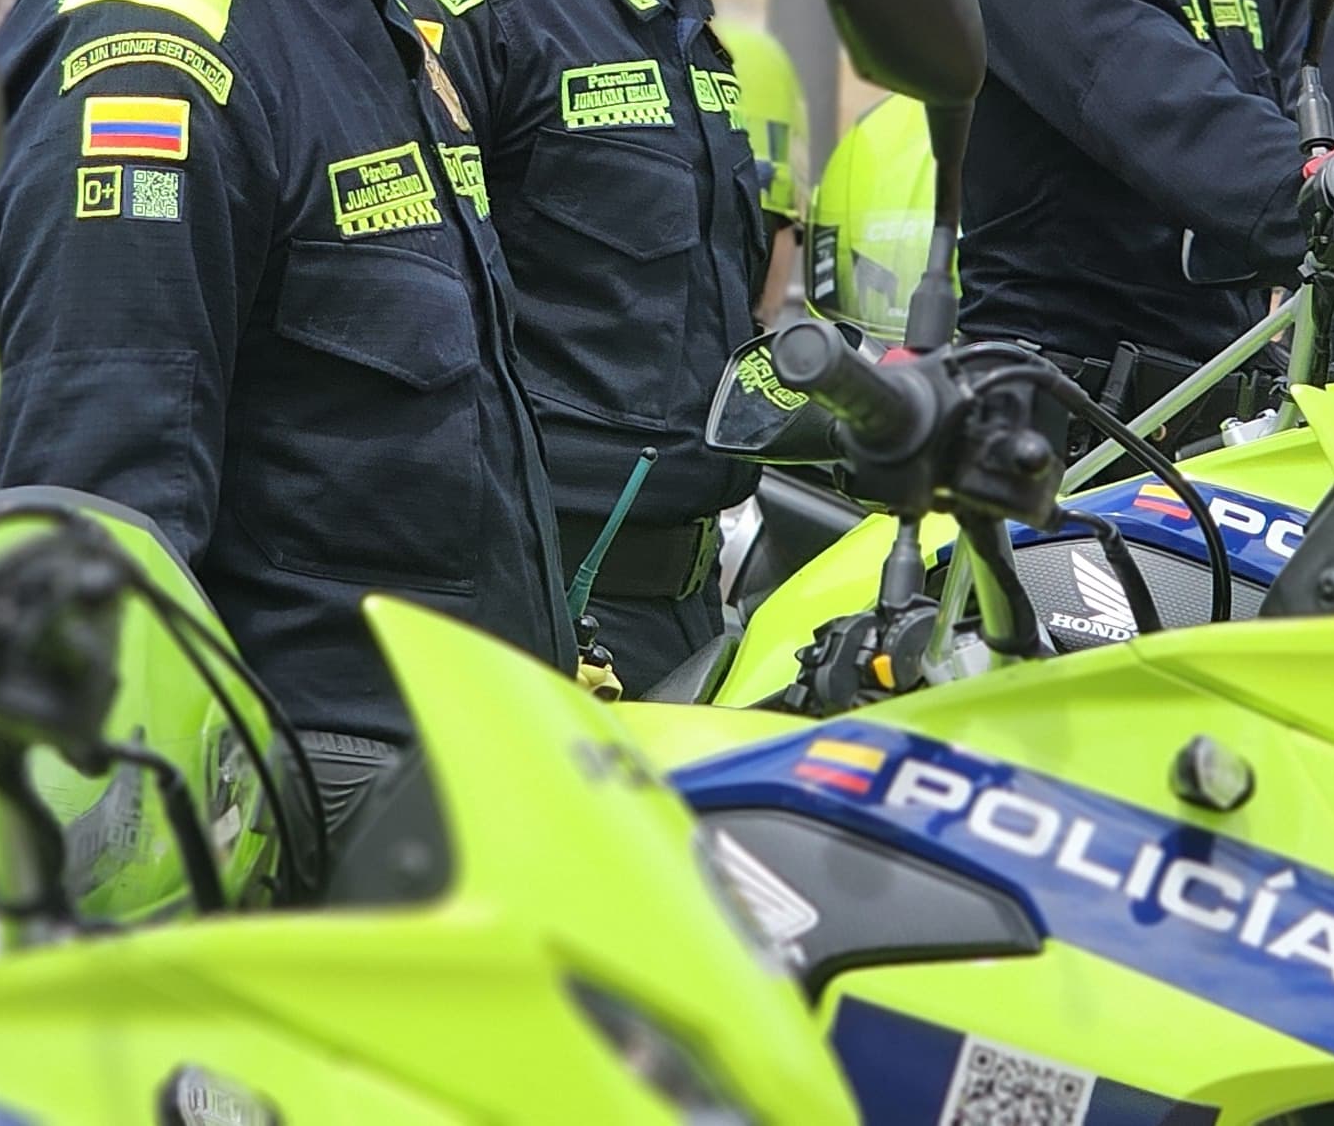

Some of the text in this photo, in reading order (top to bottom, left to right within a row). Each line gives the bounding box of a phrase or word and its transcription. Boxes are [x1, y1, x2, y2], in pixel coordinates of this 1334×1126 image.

[72, 56, 88, 76] ES
[88, 46, 109, 64] UN
[111, 39, 156, 57] HONOR
[158, 41, 183, 61] SER
[345, 183, 378, 211] JUAN
[1049, 612, 1140, 642] HOND
